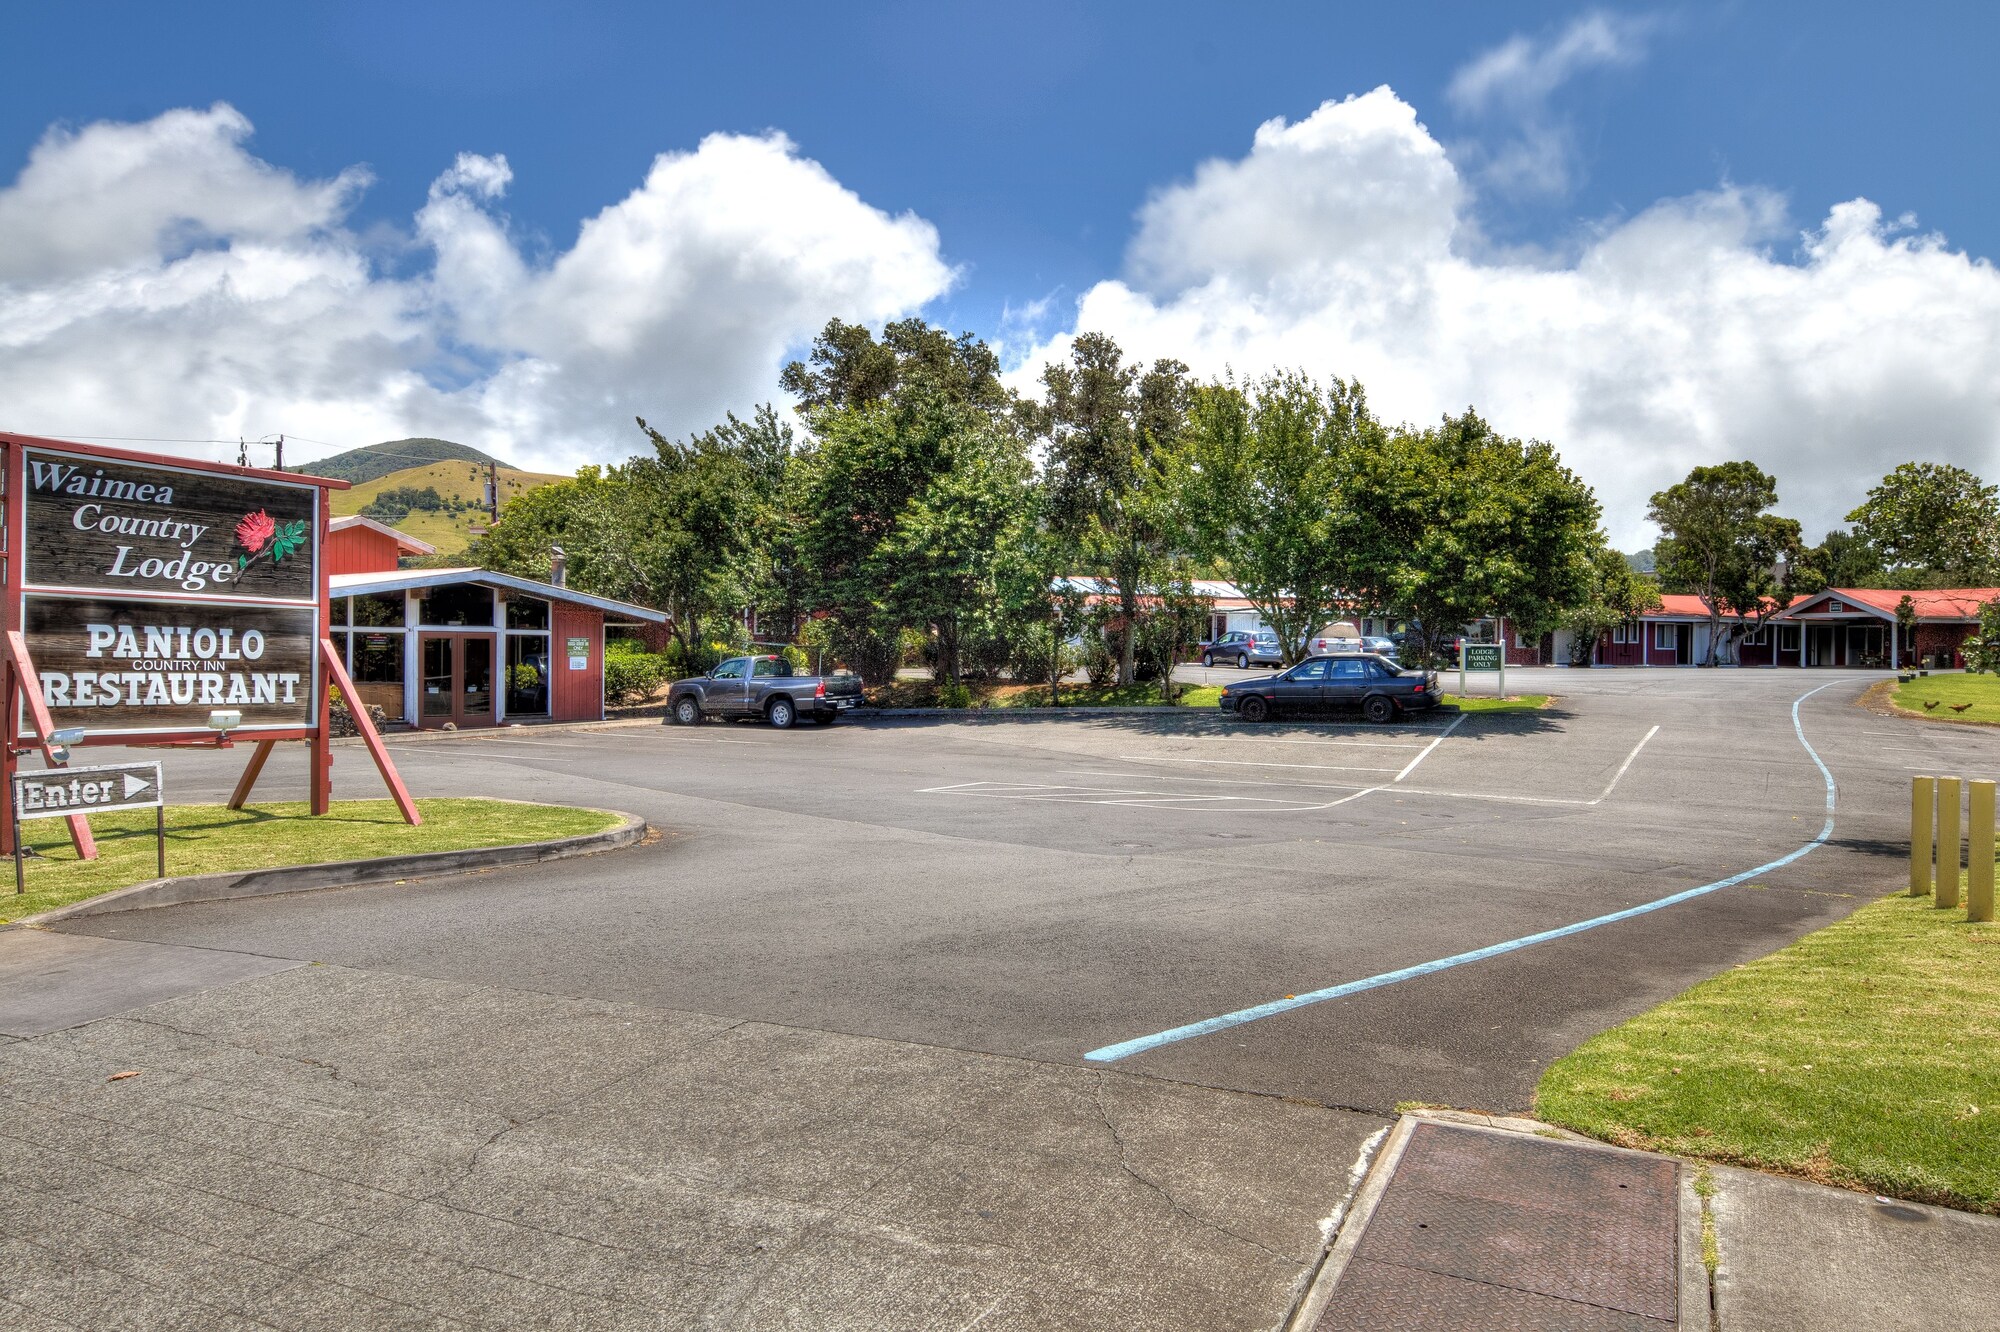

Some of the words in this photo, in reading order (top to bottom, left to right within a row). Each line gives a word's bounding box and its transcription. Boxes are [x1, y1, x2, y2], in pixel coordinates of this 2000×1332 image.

[29, 461, 174, 505] Waimea
[73, 503, 209, 548] Country
[105, 545, 234, 591] Lodge
[86, 624, 265, 660] PANIOLO
[132, 659, 201, 671] COUNTRY
[203, 660, 226, 672] INN
[40, 672, 300, 708] RESTAURANT
[24, 778, 114, 809] Enter
